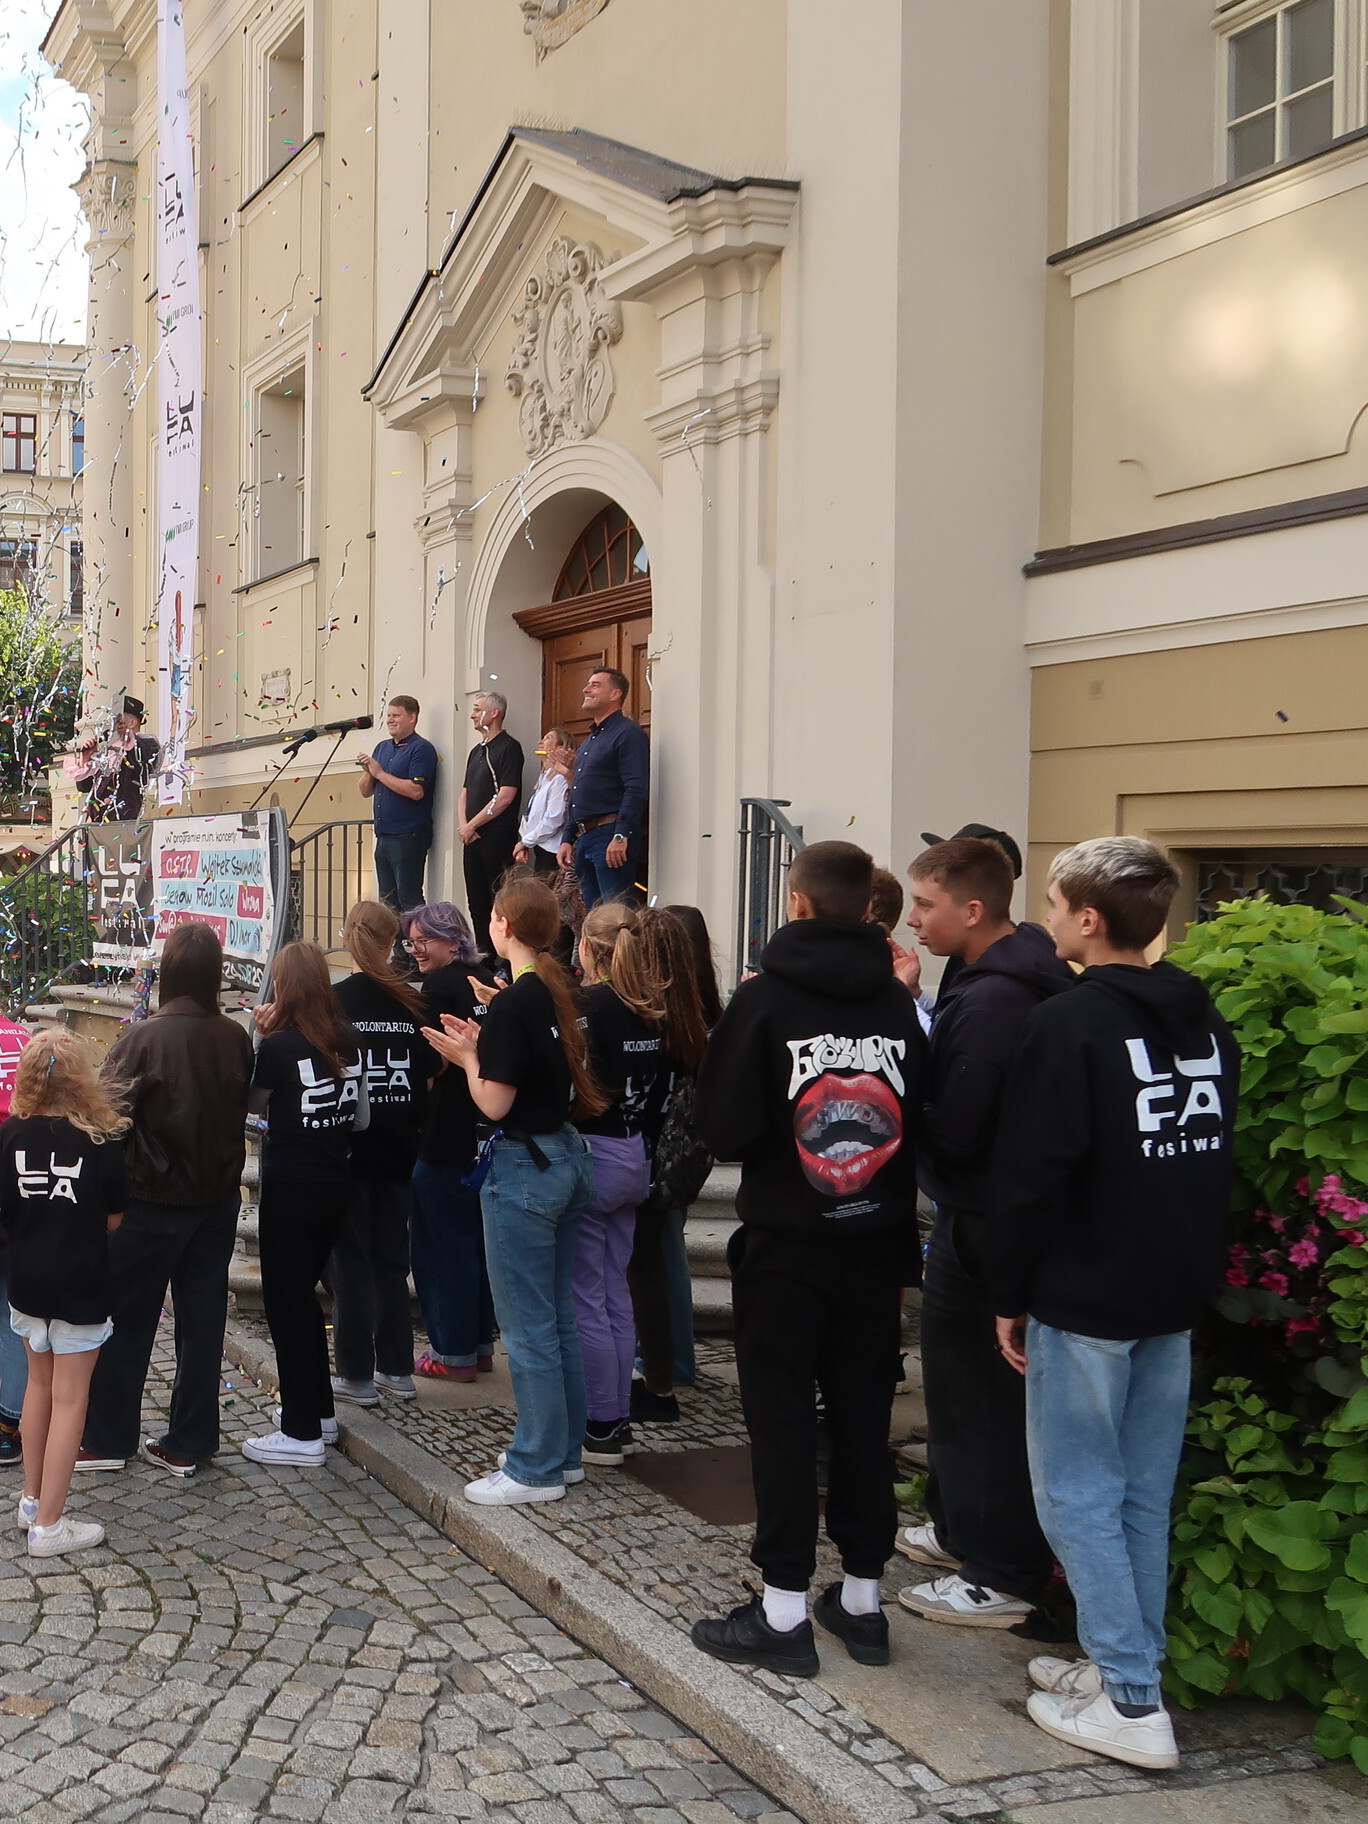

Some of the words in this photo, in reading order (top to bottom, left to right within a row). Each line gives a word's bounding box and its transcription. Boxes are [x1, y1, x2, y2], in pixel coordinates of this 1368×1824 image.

[99, 844, 141, 875] LU
[101, 879, 139, 909] FA
[367, 1048, 411, 1069] LU
[1124, 1032, 1222, 1083] LU
[367, 1070, 411, 1091] FA
[370, 1093, 411, 1103] estiwal
[1136, 1080, 1223, 1132] FA
[302, 1113, 355, 1129] festiwa
[15, 1150, 83, 1179] LU
[17, 1176, 78, 1204] FA
